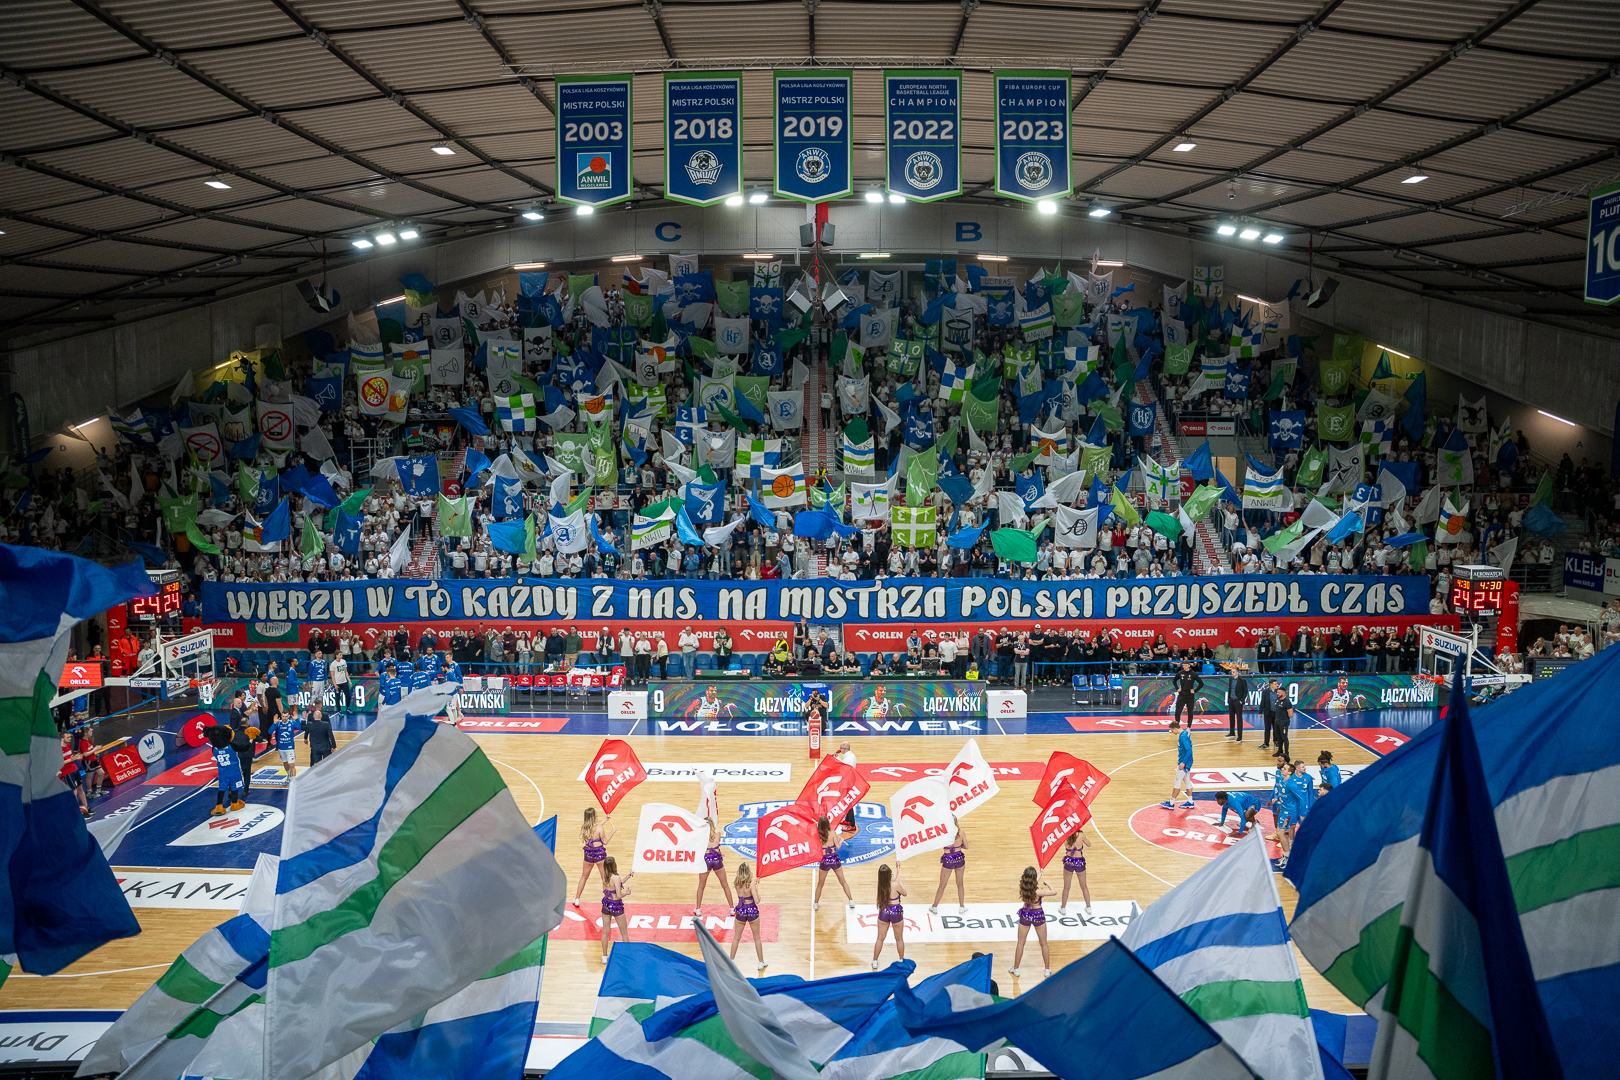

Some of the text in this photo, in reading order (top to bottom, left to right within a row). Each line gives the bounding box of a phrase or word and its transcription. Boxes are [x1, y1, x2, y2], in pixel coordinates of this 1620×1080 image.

[564, 101, 625, 110] MISTRZ POLSKI
[672, 98, 734, 107] MISTRZ POLSKI
[890, 98, 956, 106] CHAMPION
[1001, 98, 1066, 107] CHAMPION
[565, 122, 623, 142] 2003
[674, 118, 733, 140] 2018
[784, 116, 843, 137] 2019
[893, 120, 954, 140] 2022
[1003, 120, 1064, 141] 2023
[801, 149, 826, 160] ANWIL
[912, 154, 936, 165] ANWIL
[1022, 155, 1045, 166] ANWIL
[581, 176, 608, 184] ANWIL
[688, 167, 721, 180] ANWIL
[655, 222, 682, 242] C
[956, 222, 982, 242] B
[757, 266, 766, 274] K
[1195, 269, 1222, 278] K O
[1194, 285, 1221, 295] A L
[468, 302, 478, 316] A
[1021, 307, 1046, 318] ULTRAS
[611, 330, 632, 340] K O
[726, 329, 740, 343] KF
[1027, 332, 1048, 341] ANWIL
[894, 342, 921, 355] K O
[1054, 340, 1064, 349] O
[762, 353, 773, 366] A
[900, 354, 910, 364] W
[1026, 350, 1032, 360] 3
[1057, 357, 1065, 365] L
[888, 361, 915, 372] A L
[1007, 366, 1011, 376] 1
[655, 387, 661, 396] 3
[1137, 410, 1150, 425] KF
[1152, 463, 1160, 475] K
[1159, 475, 1169, 486] W
[1149, 484, 1179, 496] A L
[1251, 499, 1276, 507] ANWIL
[171, 506, 182, 517] T
[347, 529, 358, 540] T
[558, 528, 570, 542] A
[639, 530, 666, 546] ANWIL
[1457, 580, 1470, 590] 4:30
[1480, 581, 1502, 590] 4:30
[164, 592, 180, 612] 24
[226, 578, 1406, 624] WIERZY W TO KAŻDY Z NAS. NA MISTRZA POLSKI PRZYSZEDŁ CZAS
[1454, 588, 1470, 609] 24
[1474, 592, 1501, 609] 24
[134, 597, 160, 614] 24
[1124, 630, 1155, 638] ORLEN
[1189, 629, 1218, 637] ORLEN
[180, 639, 208, 655] SUZUKI
[1435, 638, 1462, 654] SUZUKI
[70, 678, 90, 686] ORLEN
[355, 686, 365, 708] 9
[455, 692, 505, 710] ĄCZYŃSKI
[1129, 685, 1139, 708] 9
[1289, 683, 1299, 706] 9
[1381, 688, 1434, 705] ŁĄCZYŃSKI
[654, 690, 664, 713] 9
[923, 696, 981, 714] ŁĄCZYŃSKI
[458, 720, 542, 729] ORLEN
[116, 767, 142, 782] Bank Pekao
[709, 768, 784, 778] Pekao
[924, 767, 1022, 776] OEN
[601, 766, 636, 804] ORLEN
[950, 780, 990, 812] ORLEN
[826, 786, 862, 822] ORLEN
[228, 811, 275, 839] SUZUKI
[900, 823, 948, 850] ORLEN
[1041, 812, 1081, 854] ORLEN
[1163, 828, 1239, 846] ORLE
[643, 849, 696, 863] ORLEN
[762, 841, 811, 866] ORLEN
[846, 846, 891, 863] ANTYKOROZJA
